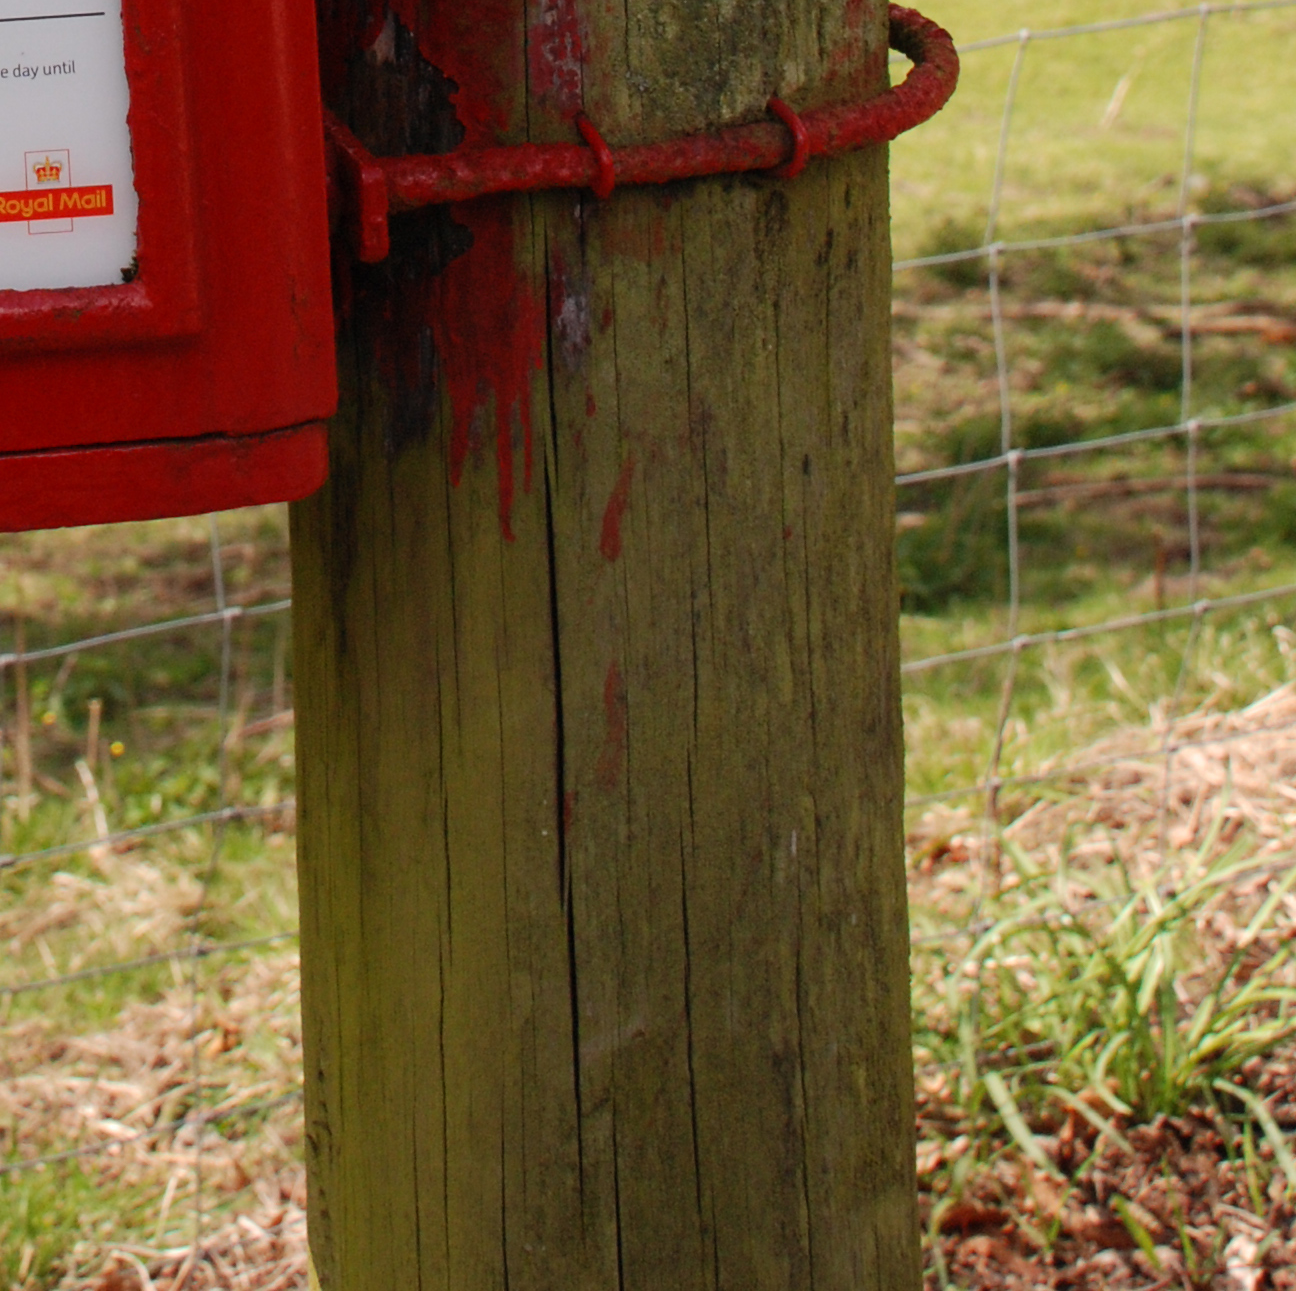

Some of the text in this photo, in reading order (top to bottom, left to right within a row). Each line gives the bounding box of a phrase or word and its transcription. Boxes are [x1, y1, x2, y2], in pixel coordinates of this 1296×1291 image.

[12, 63, 39, 80] day
[42, 60, 76, 76] until
[59, 190, 107, 210] Mail
